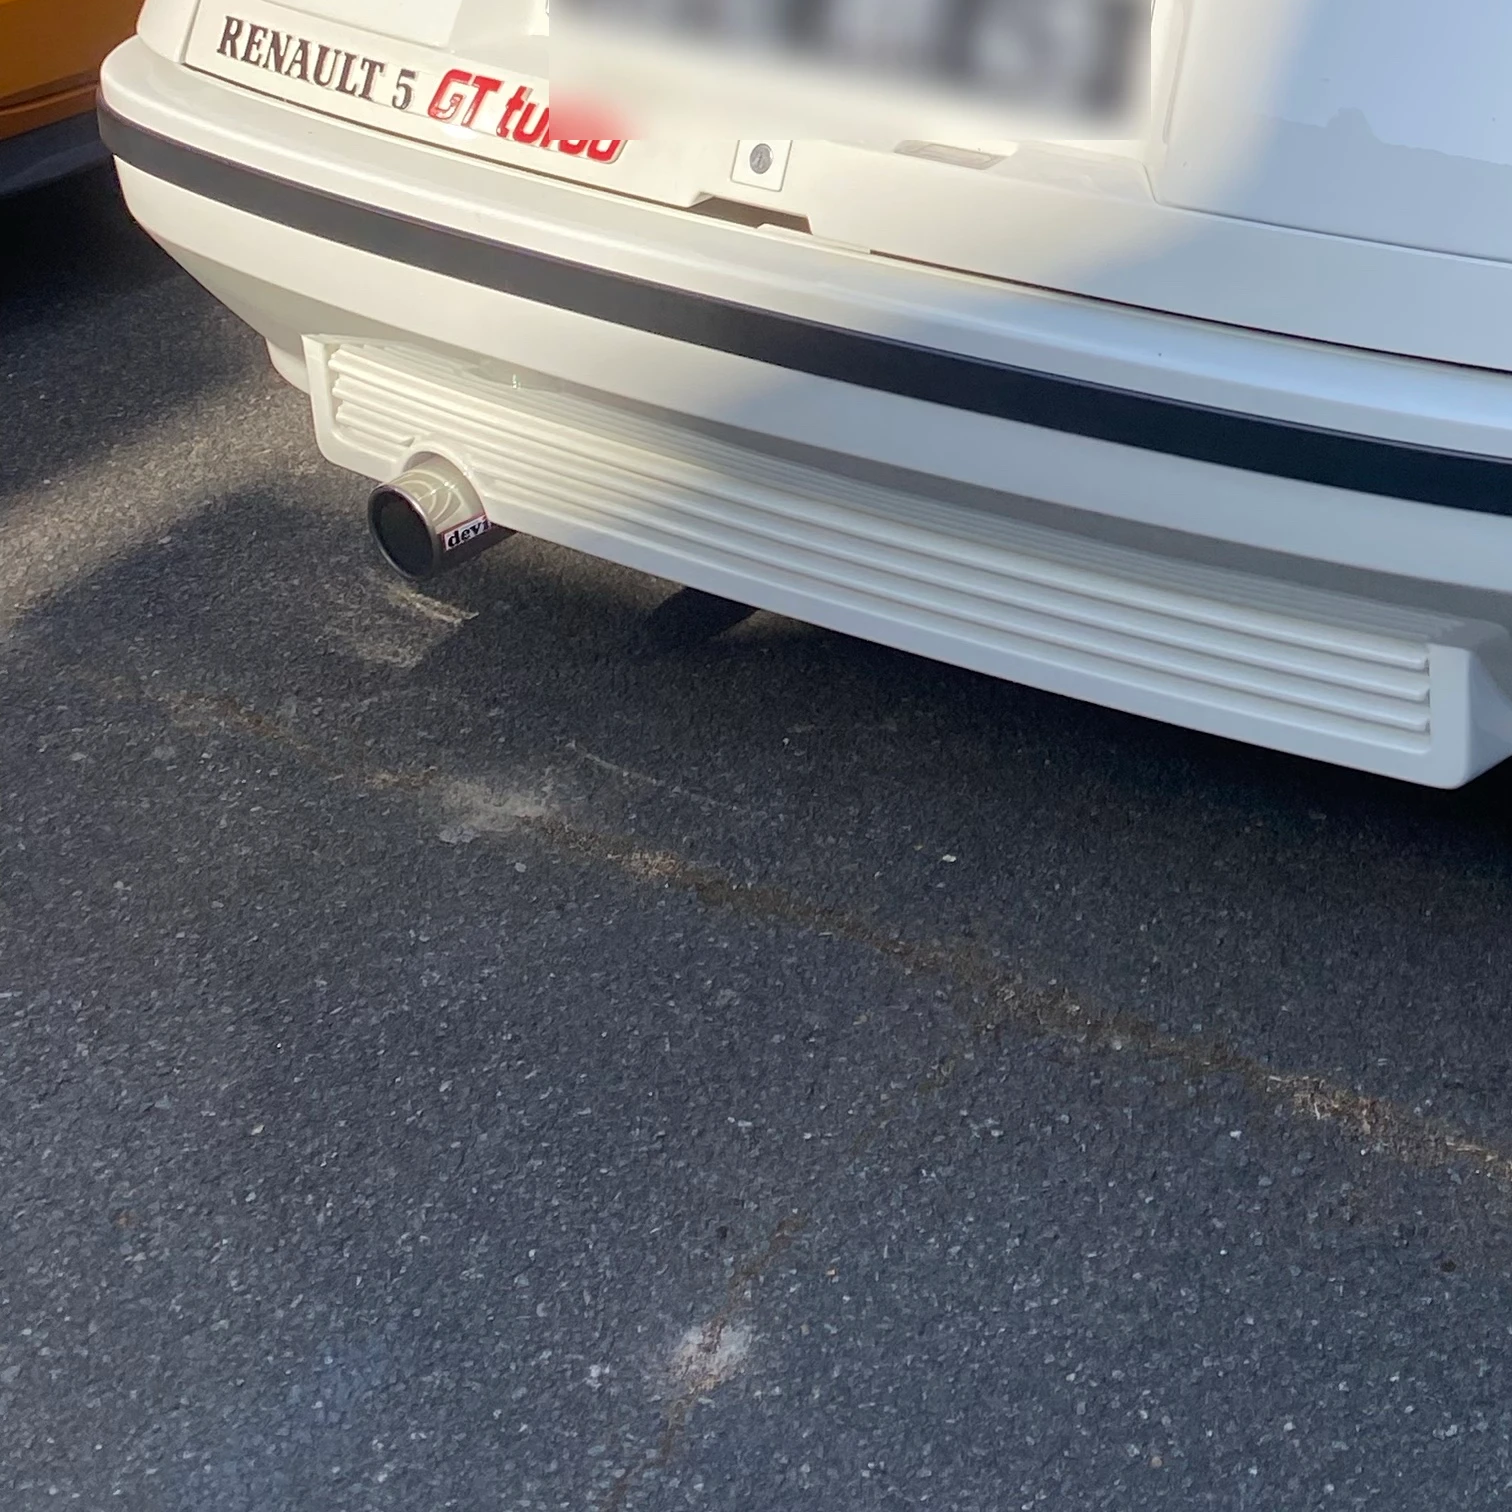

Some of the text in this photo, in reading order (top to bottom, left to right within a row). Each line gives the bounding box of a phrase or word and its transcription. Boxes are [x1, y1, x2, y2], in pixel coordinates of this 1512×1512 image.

[217, 15, 624, 162] RENAULT 5 GT tuo
